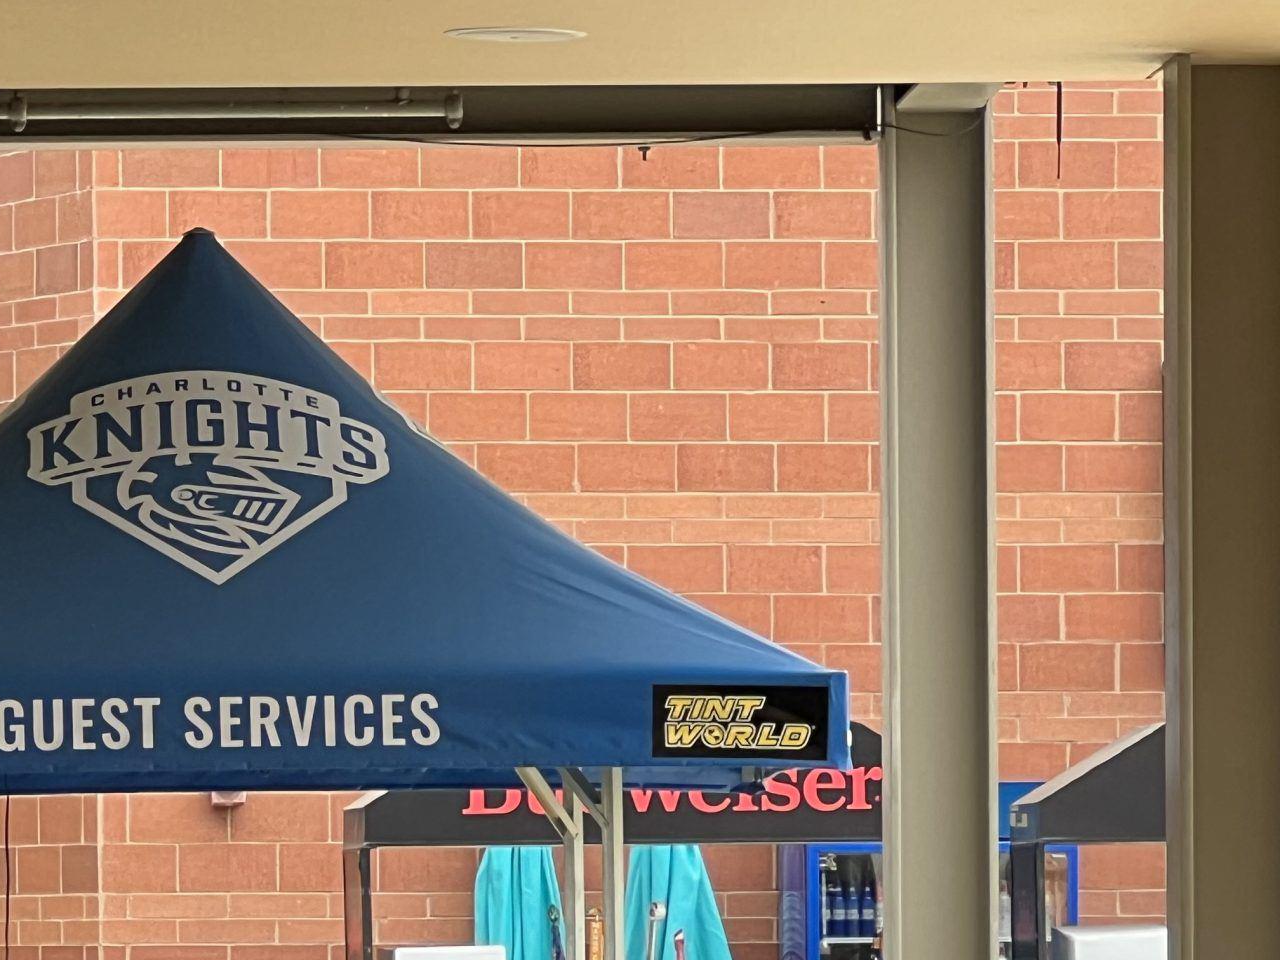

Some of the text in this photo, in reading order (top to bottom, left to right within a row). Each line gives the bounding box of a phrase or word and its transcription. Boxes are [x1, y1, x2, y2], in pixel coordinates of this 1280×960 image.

[91, 378, 320, 409] CHARLOTTE
[39, 398, 378, 472] KNIGHTS
[183, 693, 441, 749] SERVICES
[665, 695, 766, 722] TINT
